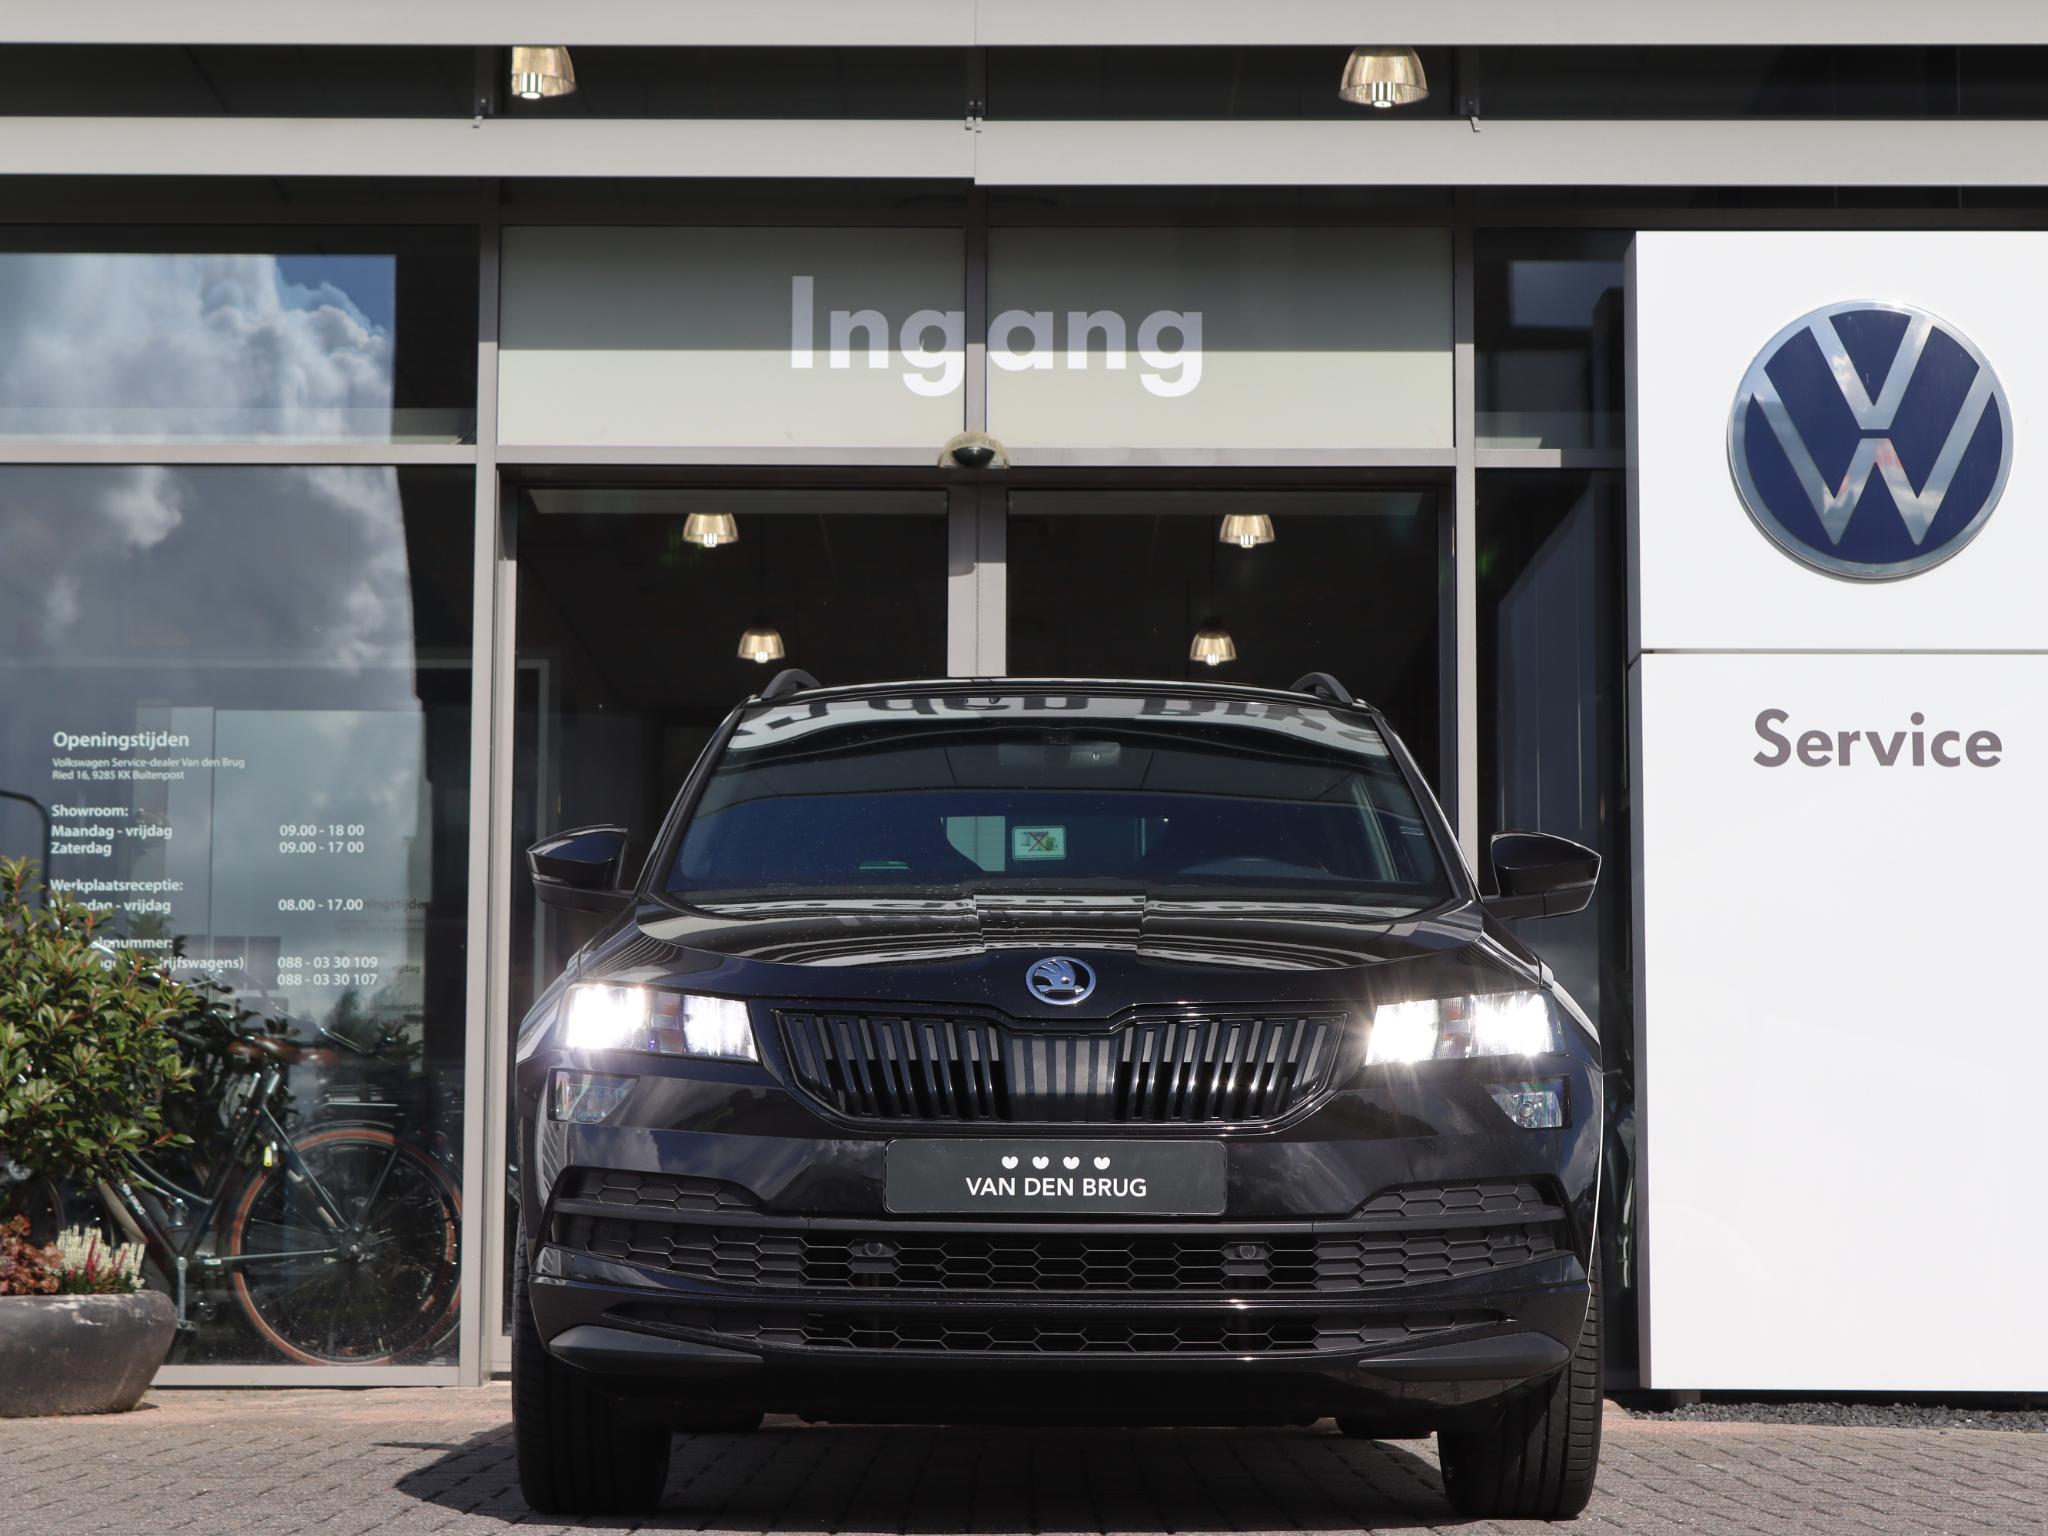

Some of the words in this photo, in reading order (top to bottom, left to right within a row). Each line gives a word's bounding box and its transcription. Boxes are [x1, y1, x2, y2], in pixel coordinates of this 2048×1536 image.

[791, 276, 1203, 397] Ingang
[53, 731, 190, 751] Openingstijden
[1752, 708, 2003, 769] Service
[52, 757, 110, 769] Volkswagen
[111, 757, 180, 768] Service-dealer
[181, 757, 200, 768] Van
[201, 757, 221, 768] den
[221, 757, 245, 769] Brug
[52, 770, 74, 780] Ried
[76, 770, 90, 781] 16,
[92, 770, 116, 780] 9285
[117, 770, 131, 780] KK
[132, 770, 184, 782] Buitenpost
[51, 804, 129, 817] Showroom:
[51, 824, 115, 840] Maandag
[125, 824, 172, 840] vrijdag
[279, 824, 317, 836] 09.00
[51, 841, 112, 857] Zaterdag
[279, 841, 317, 853] 09.00
[50, 879, 184, 894] Werkplaatsreceptie:
[123, 899, 171, 914] vrijdag
[278, 899, 316, 911] 08.00
[327, 899, 364, 911] 17.00
[277, 956, 302, 968] 088
[313, 956, 331, 968] 03
[333, 956, 350, 968] 30
[354, 956, 378, 968] 109
[277, 973, 302, 985] 088
[313, 973, 331, 985] 03
[333, 973, 350, 985] 30
[354, 973, 378, 985] 107
[966, 1177, 1016, 1196] VAN
[1024, 1177, 1075, 1196] DEN
[1082, 1178, 1147, 1197] BRUG
